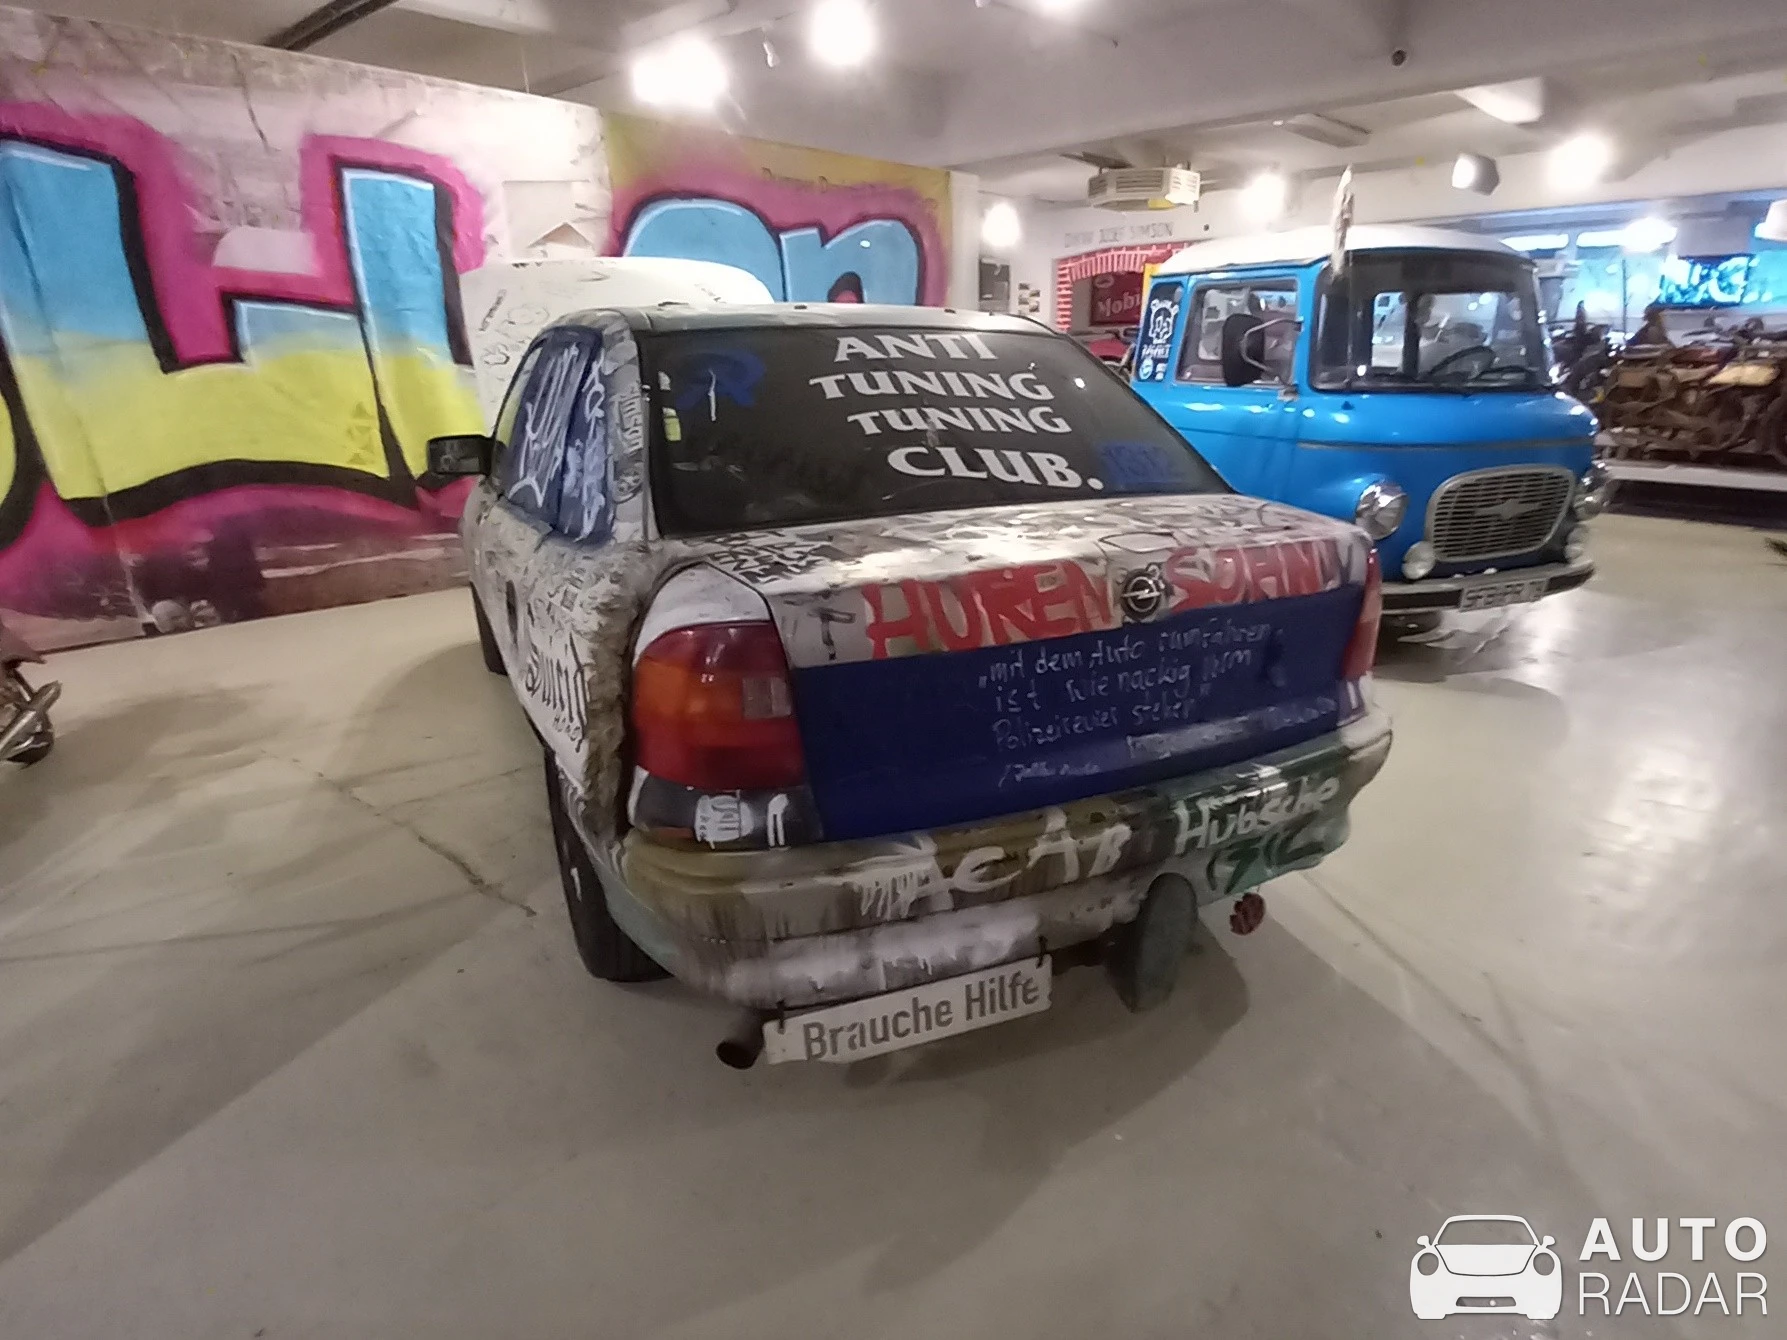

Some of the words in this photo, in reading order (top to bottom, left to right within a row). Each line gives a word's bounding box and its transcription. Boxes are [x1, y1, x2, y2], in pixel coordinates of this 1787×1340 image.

[1098, 290, 1142, 317] Mobi
[834, 334, 999, 363] ANTI
[809, 370, 1055, 400] TUNING
[847, 406, 1073, 436] TUNING
[887, 446, 1105, 491] CLUB.
[865, 561, 1114, 660] HUREN
[1166, 544, 1339, 612] SOHN
[1034, 646, 1084, 674] dem
[1088, 634, 1146, 669] Auto
[995, 679, 1042, 712] ist
[803, 997, 953, 1060] Brauche
[964, 971, 1040, 1021] Hilfe
